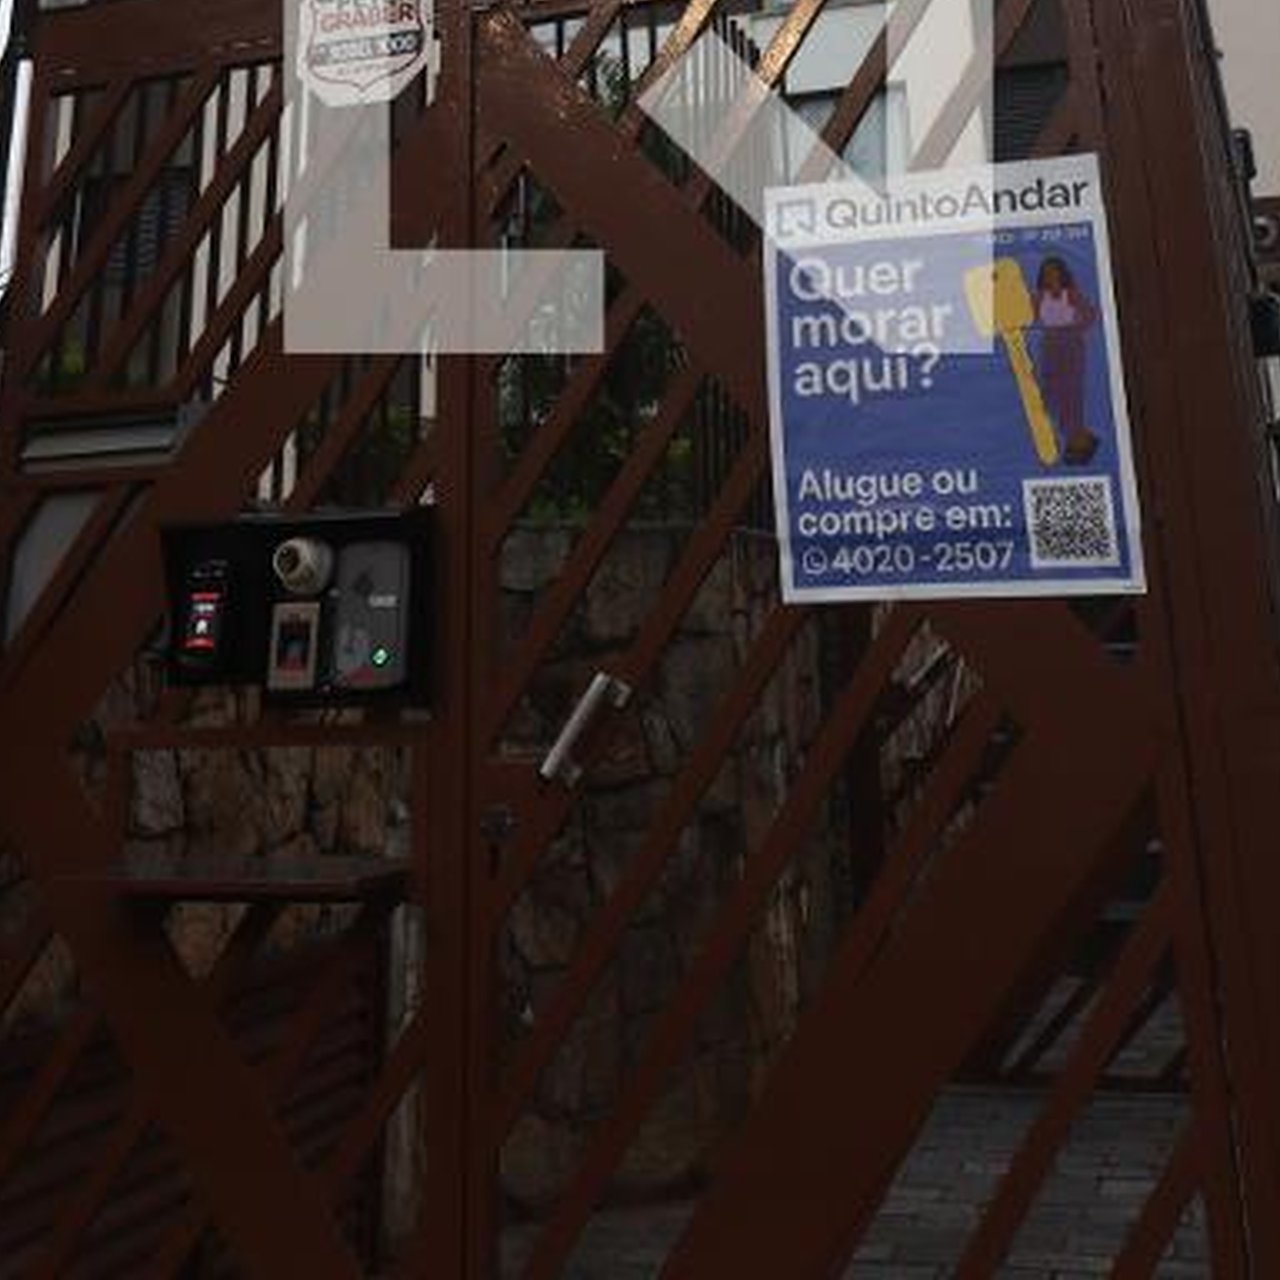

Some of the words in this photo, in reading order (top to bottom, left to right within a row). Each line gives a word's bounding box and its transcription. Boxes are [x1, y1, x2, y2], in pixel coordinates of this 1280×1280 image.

[825, 178, 1090, 232] QuintoAndar
[789, 254, 923, 302] Quer
[792, 303, 954, 348] morar
[794, 343, 941, 404] aqui?
[797, 469, 922, 507] Alugue
[932, 469, 978, 496] ou
[797, 506, 935, 540] compre
[945, 504, 1013, 531] em:
